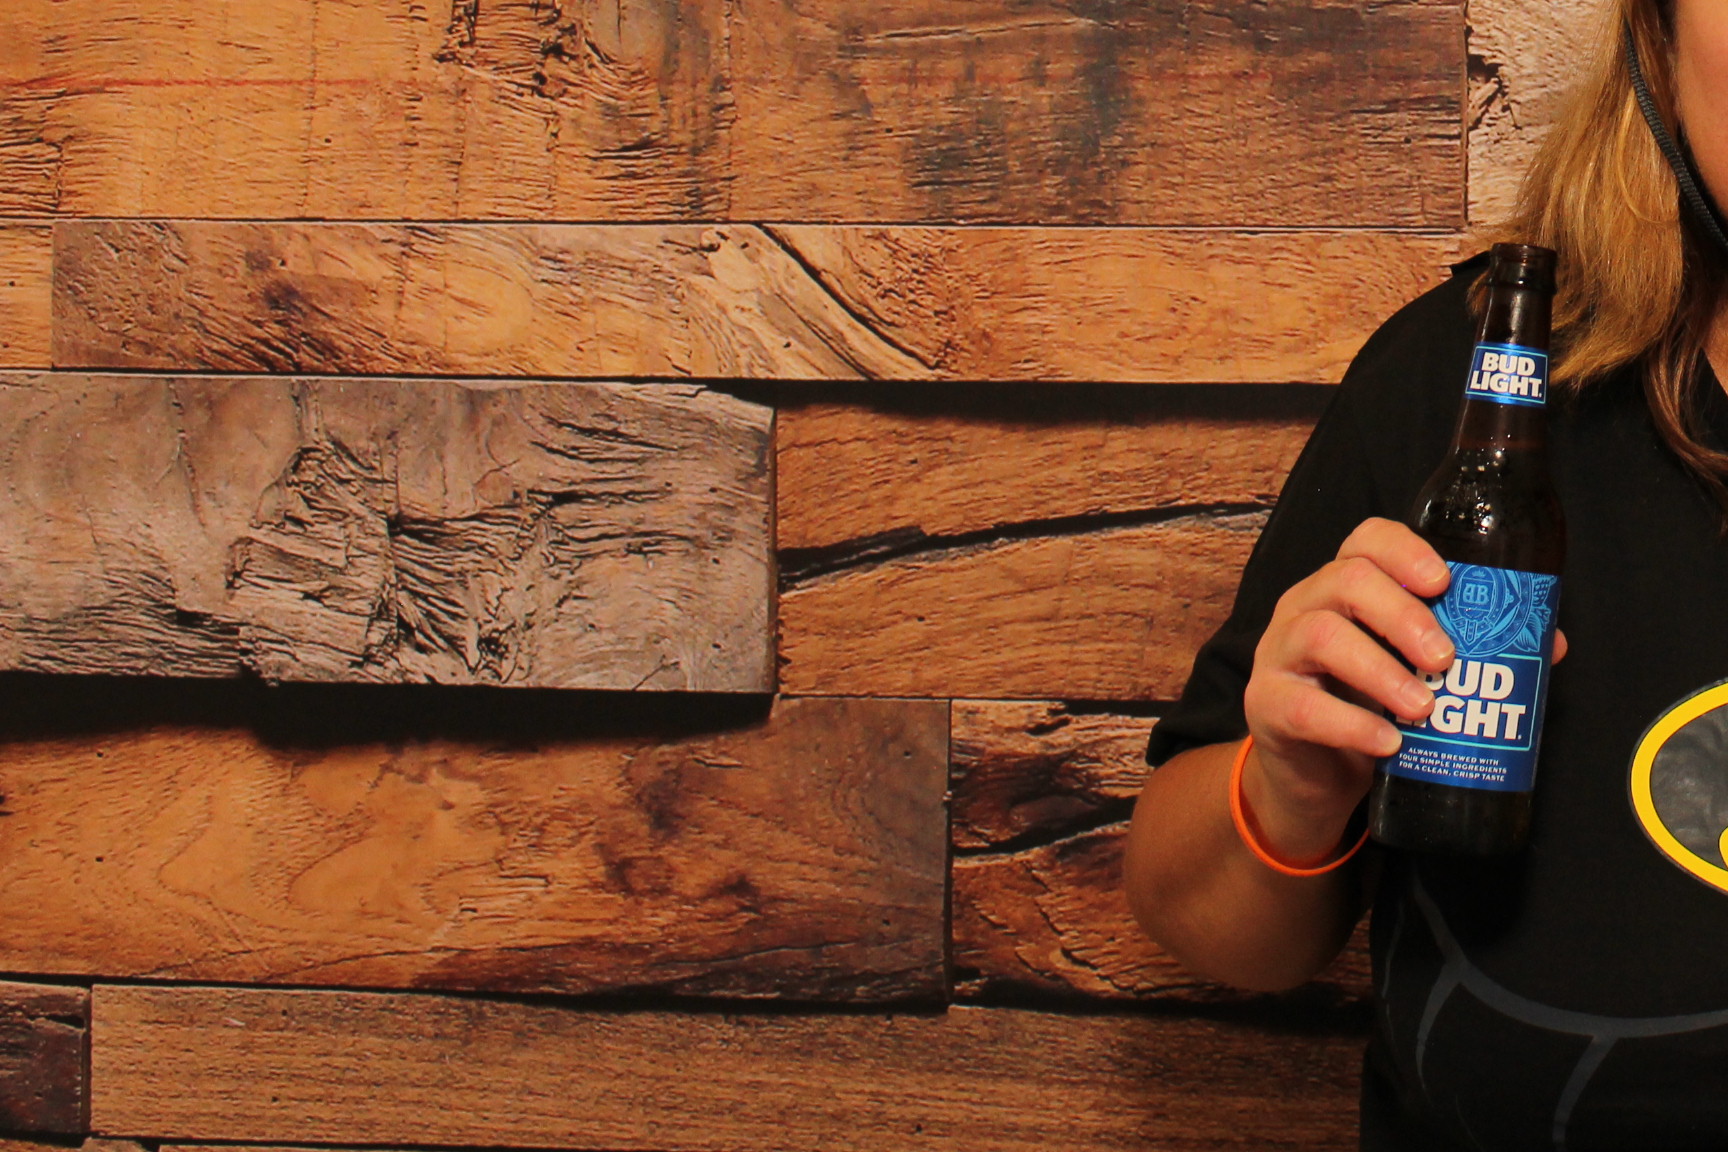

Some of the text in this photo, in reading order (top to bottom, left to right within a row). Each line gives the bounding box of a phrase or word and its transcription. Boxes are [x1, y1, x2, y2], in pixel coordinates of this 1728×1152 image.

[1481, 351, 1536, 377] BUD
[1469, 370, 1543, 397] LIGHT
[1396, 694, 1527, 740] GHT
[1398, 752, 1508, 774] FOUR SIMPLE INGREDIENTS
[1408, 747, 1499, 766] ALWAYS BREWED WITH
[1399, 760, 1506, 782] FOR A CLEAN, CRISP TASTE
